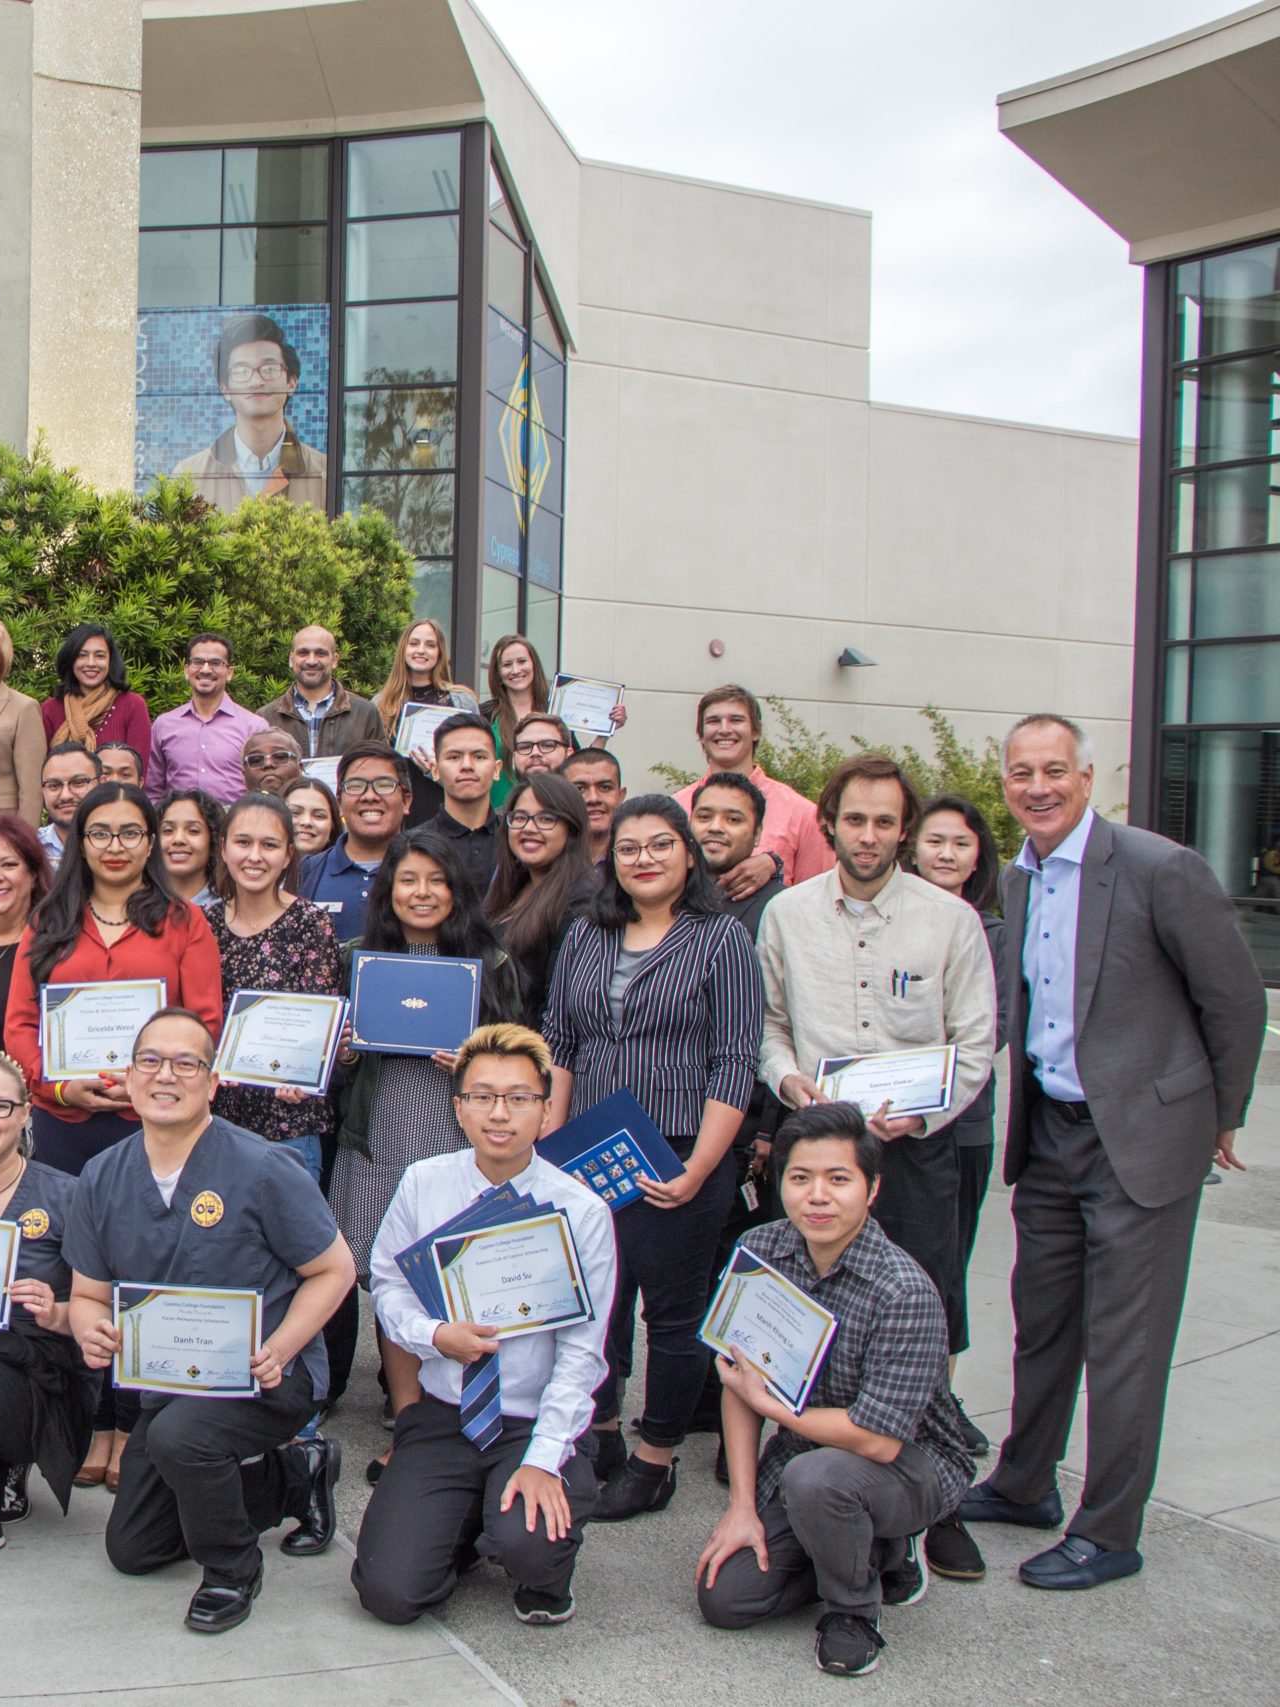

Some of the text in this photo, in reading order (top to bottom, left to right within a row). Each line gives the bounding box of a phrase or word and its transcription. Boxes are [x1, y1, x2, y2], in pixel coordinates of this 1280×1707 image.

[501, 1272, 532, 1284] David Su
[173, 1335, 214, 1346] Danh Tran
